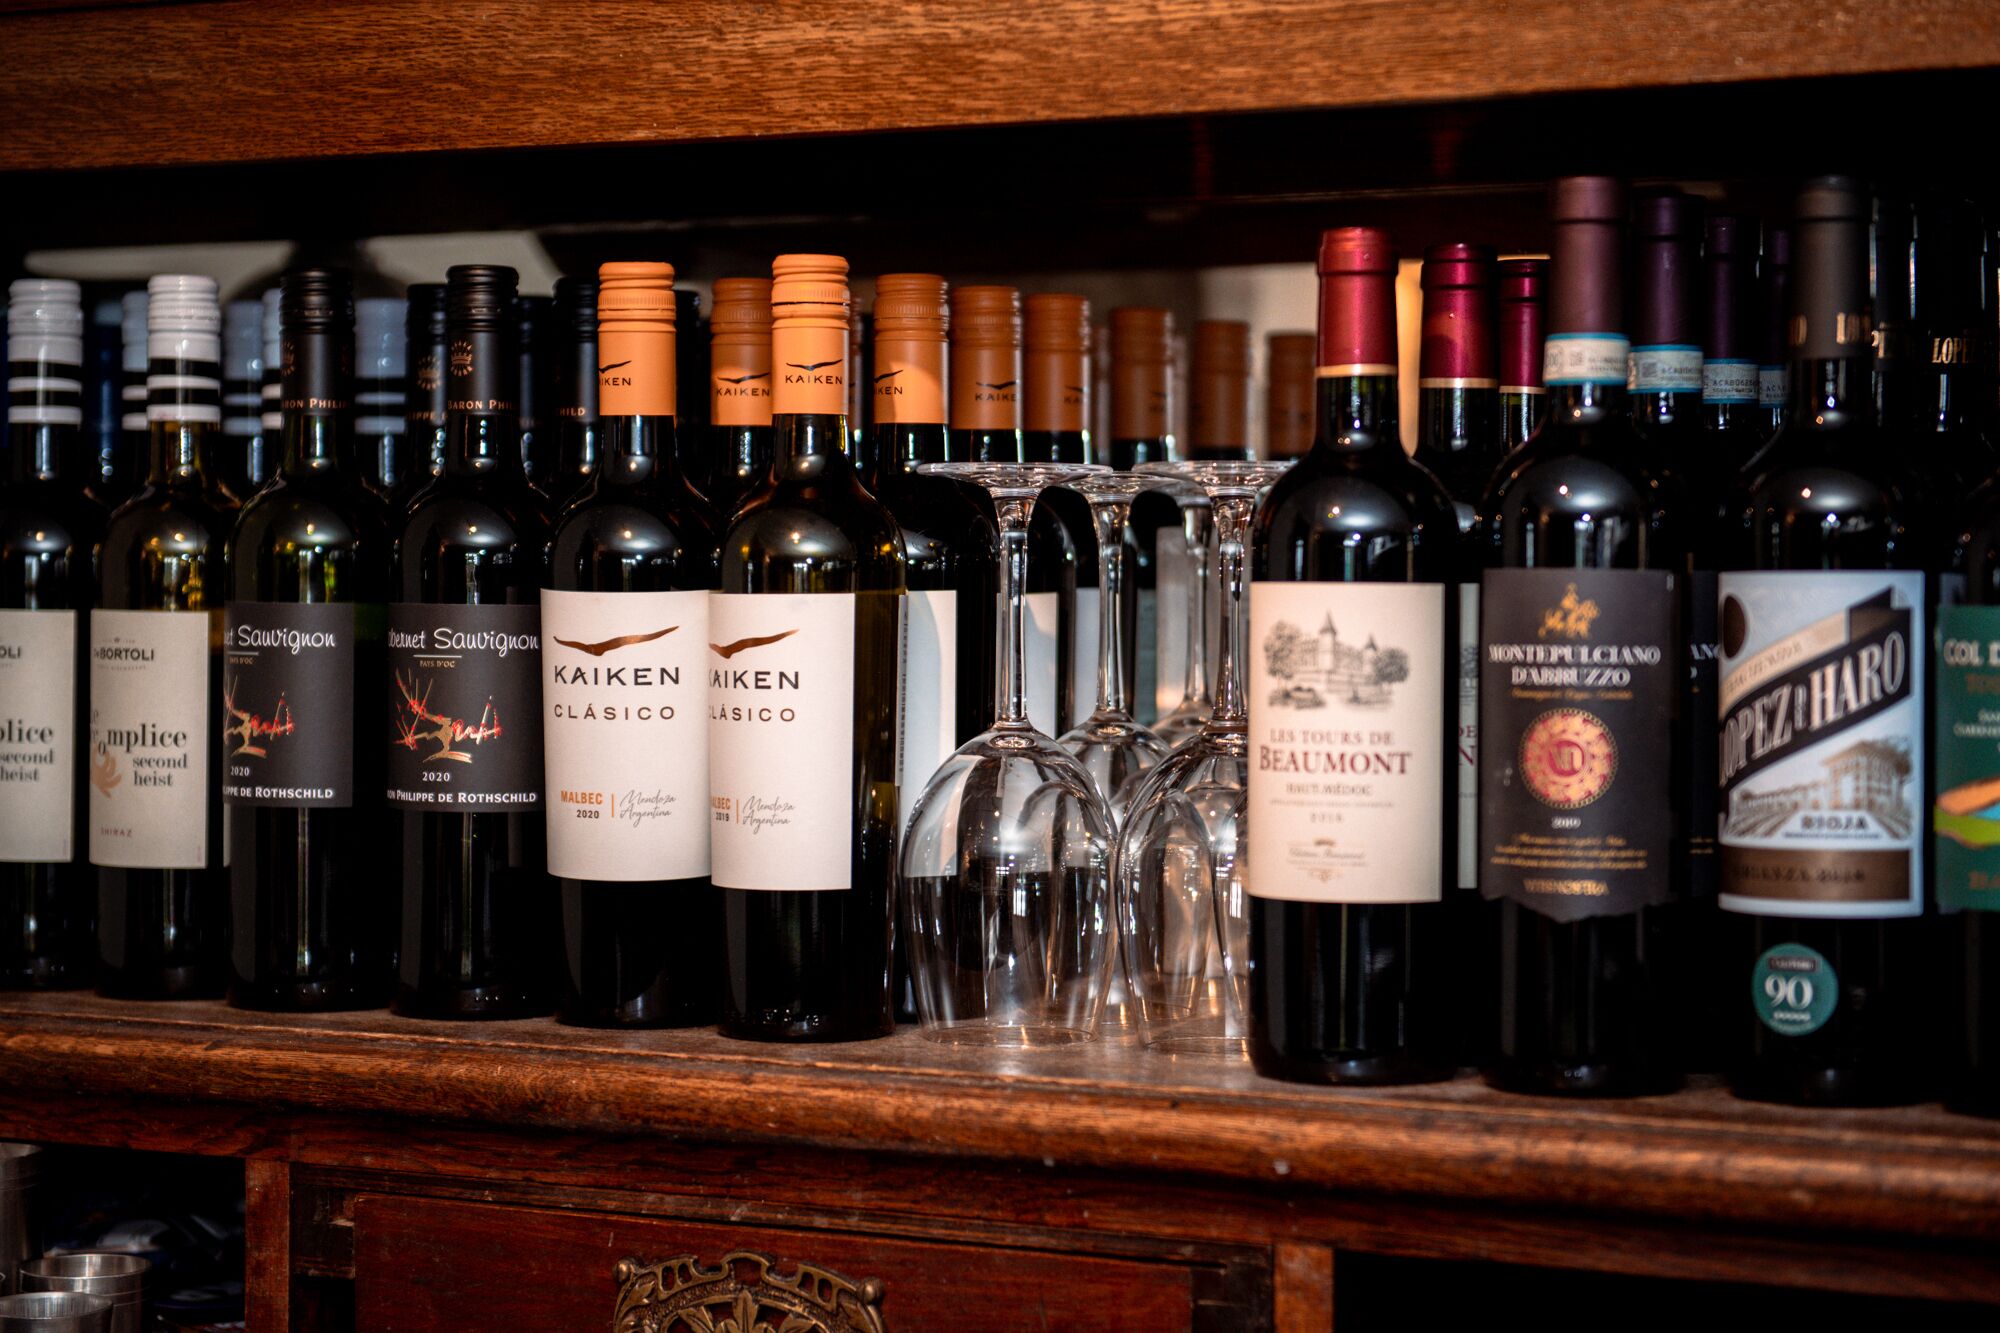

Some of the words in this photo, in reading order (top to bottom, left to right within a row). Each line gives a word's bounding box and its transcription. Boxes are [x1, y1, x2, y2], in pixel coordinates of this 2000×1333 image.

[599, 377, 632, 386] IKEN
[785, 375, 843, 385] KAIKEN
[716, 387, 771, 397] KAIKEN
[975, 392, 1017, 402] KAIKE
[447, 400, 483, 410] BARON
[237, 624, 336, 656] Sauvignon
[433, 626, 538, 657] Sauvignon
[1488, 643, 1662, 666] MONTEPULCIANO
[1943, 638, 1984, 667] COL
[436, 660, 456, 669] D'OC
[554, 665, 680, 686] KAIKEN
[1511, 665, 1632, 687] D'ABRUZZO
[1808, 630, 1906, 732] HARO
[554, 703, 675, 721] CLÁSICO
[1269, 728, 1295, 744] LES
[1301, 729, 1364, 745] TOURS
[1369, 731, 1395, 747] DE
[132, 753, 188, 769] second
[1259, 744, 1413, 776] BEAUMONT
[133, 770, 174, 787] heist
[422, 771, 451, 782] 2020
[240, 787, 252, 798] DE
[254, 786, 335, 799] ROTHSCHILD
[396, 789, 435, 803] PHILIPPE
[438, 792, 454, 803] DE
[457, 792, 537, 803] ROTHSCHILD
[560, 790, 604, 806] MALBEC
[619, 789, 677, 807] Mendoza
[742, 795, 795, 812] Mendoza
[576, 808, 600, 820] 2020
[619, 804, 673, 829] Argentina
[742, 810, 791, 835] Argentina
[1801, 814, 1869, 831] RIOJA
[1764, 974, 1814, 1010] 90
